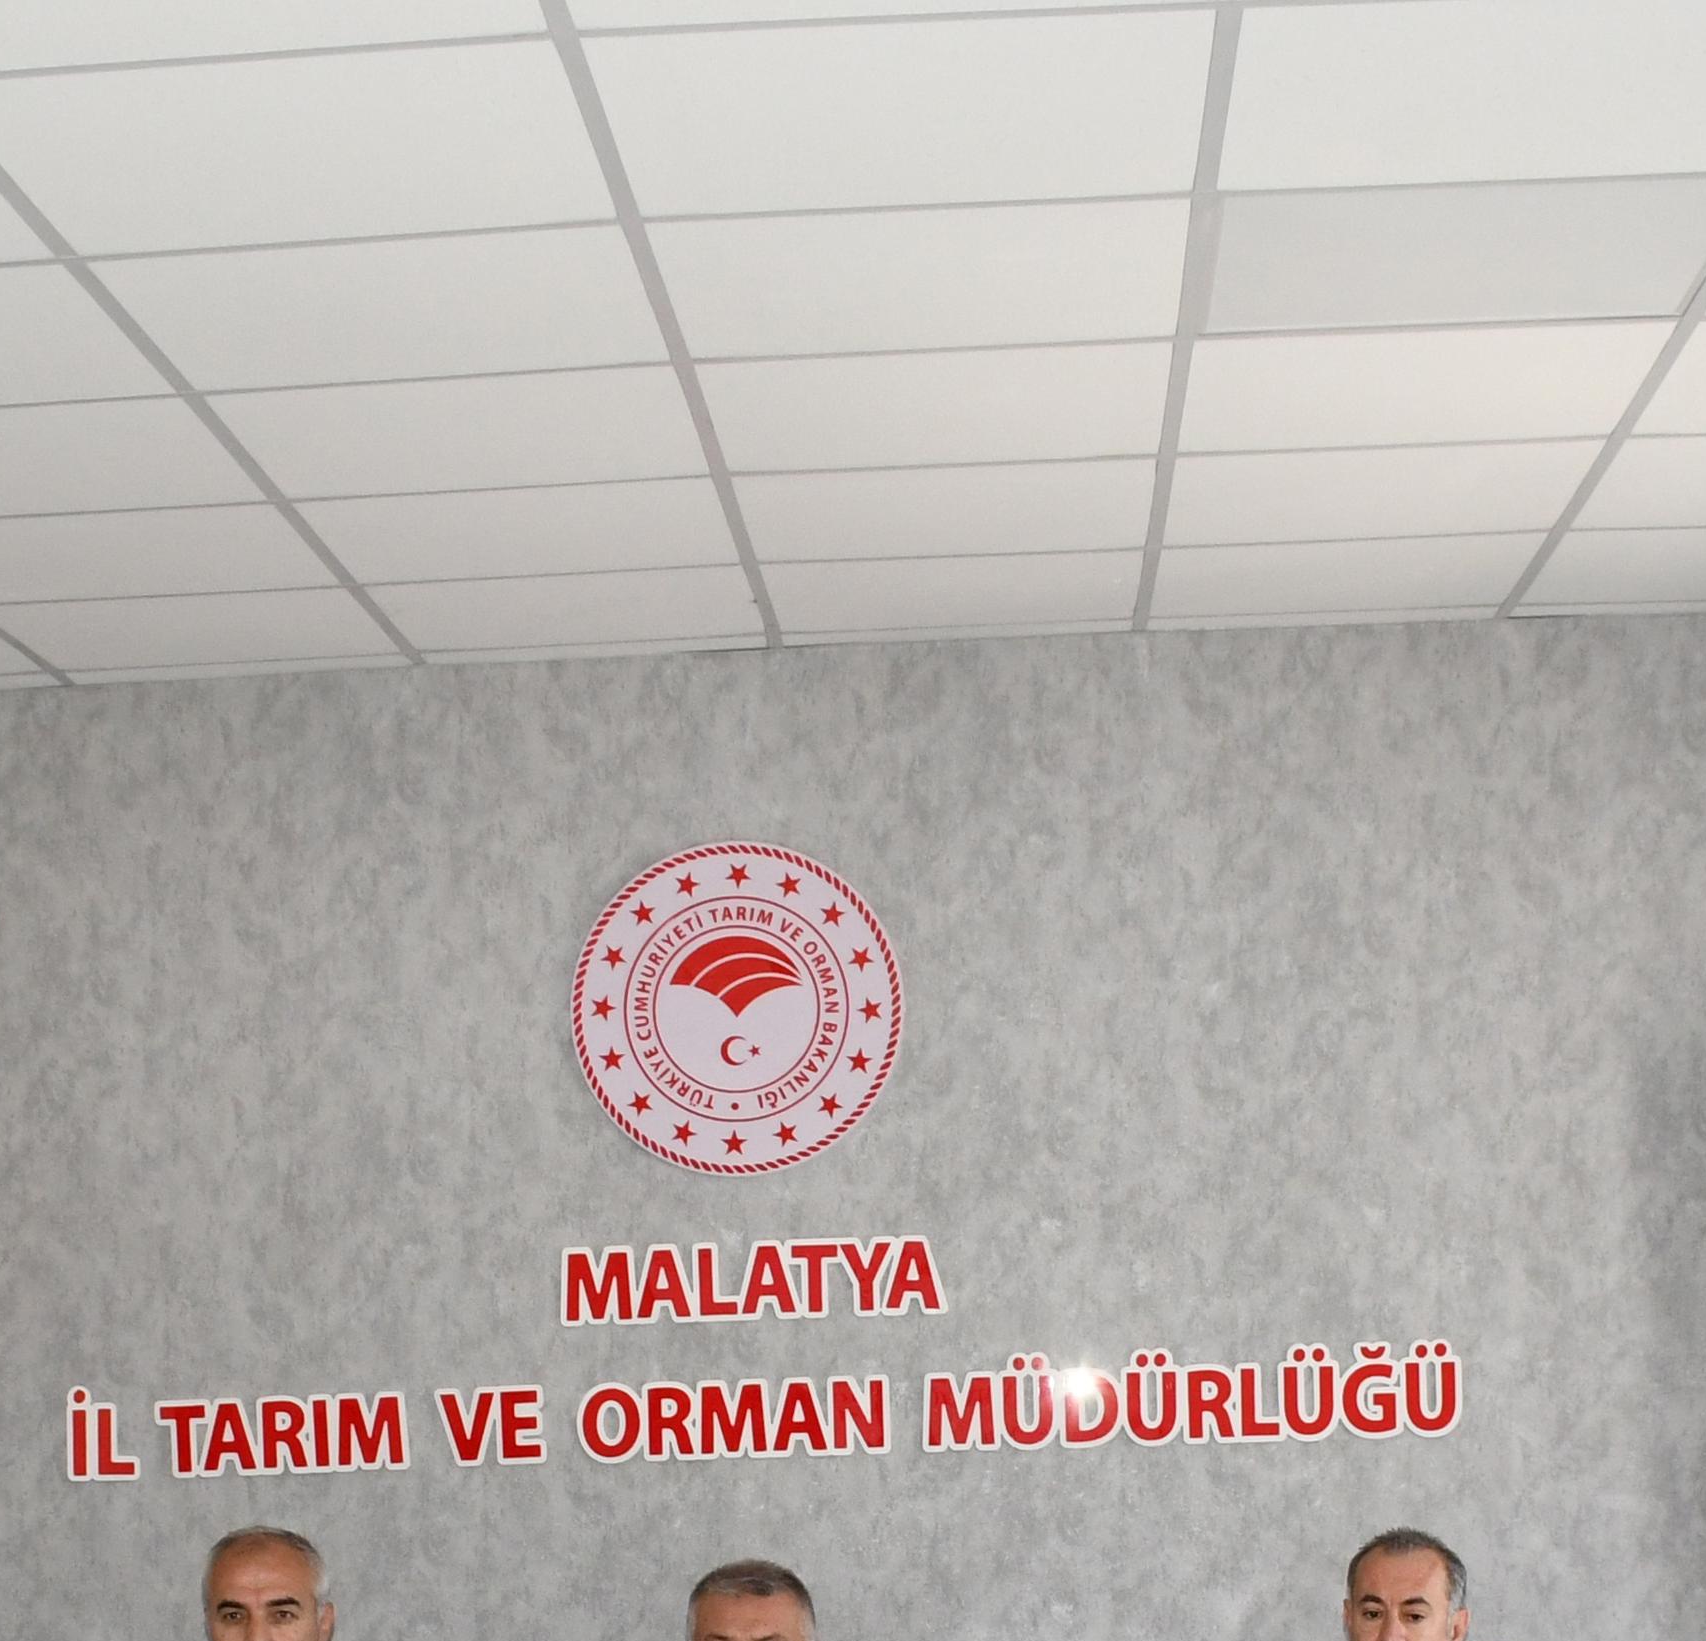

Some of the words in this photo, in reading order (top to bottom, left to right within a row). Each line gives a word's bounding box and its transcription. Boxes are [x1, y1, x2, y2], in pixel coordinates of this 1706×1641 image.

[707, 905, 774, 927] TARIM
[779, 917, 805, 943] VE
[633, 911, 704, 1042] CUMHURİYETİ
[803, 940, 840, 1014] ORMAN
[642, 1045, 714, 1110] TÜRKİYE
[756, 1021, 839, 1110] BAKANLIĞI
[564, 1238, 942, 1323] MALATYA
[72, 1389, 138, 1477] İL
[160, 1394, 406, 1473] TARIM
[441, 1388, 544, 1463] VE
[582, 1377, 887, 1459] ORMAN
[926, 1341, 1459, 1448] MÜDÜRLÜĞÜ
